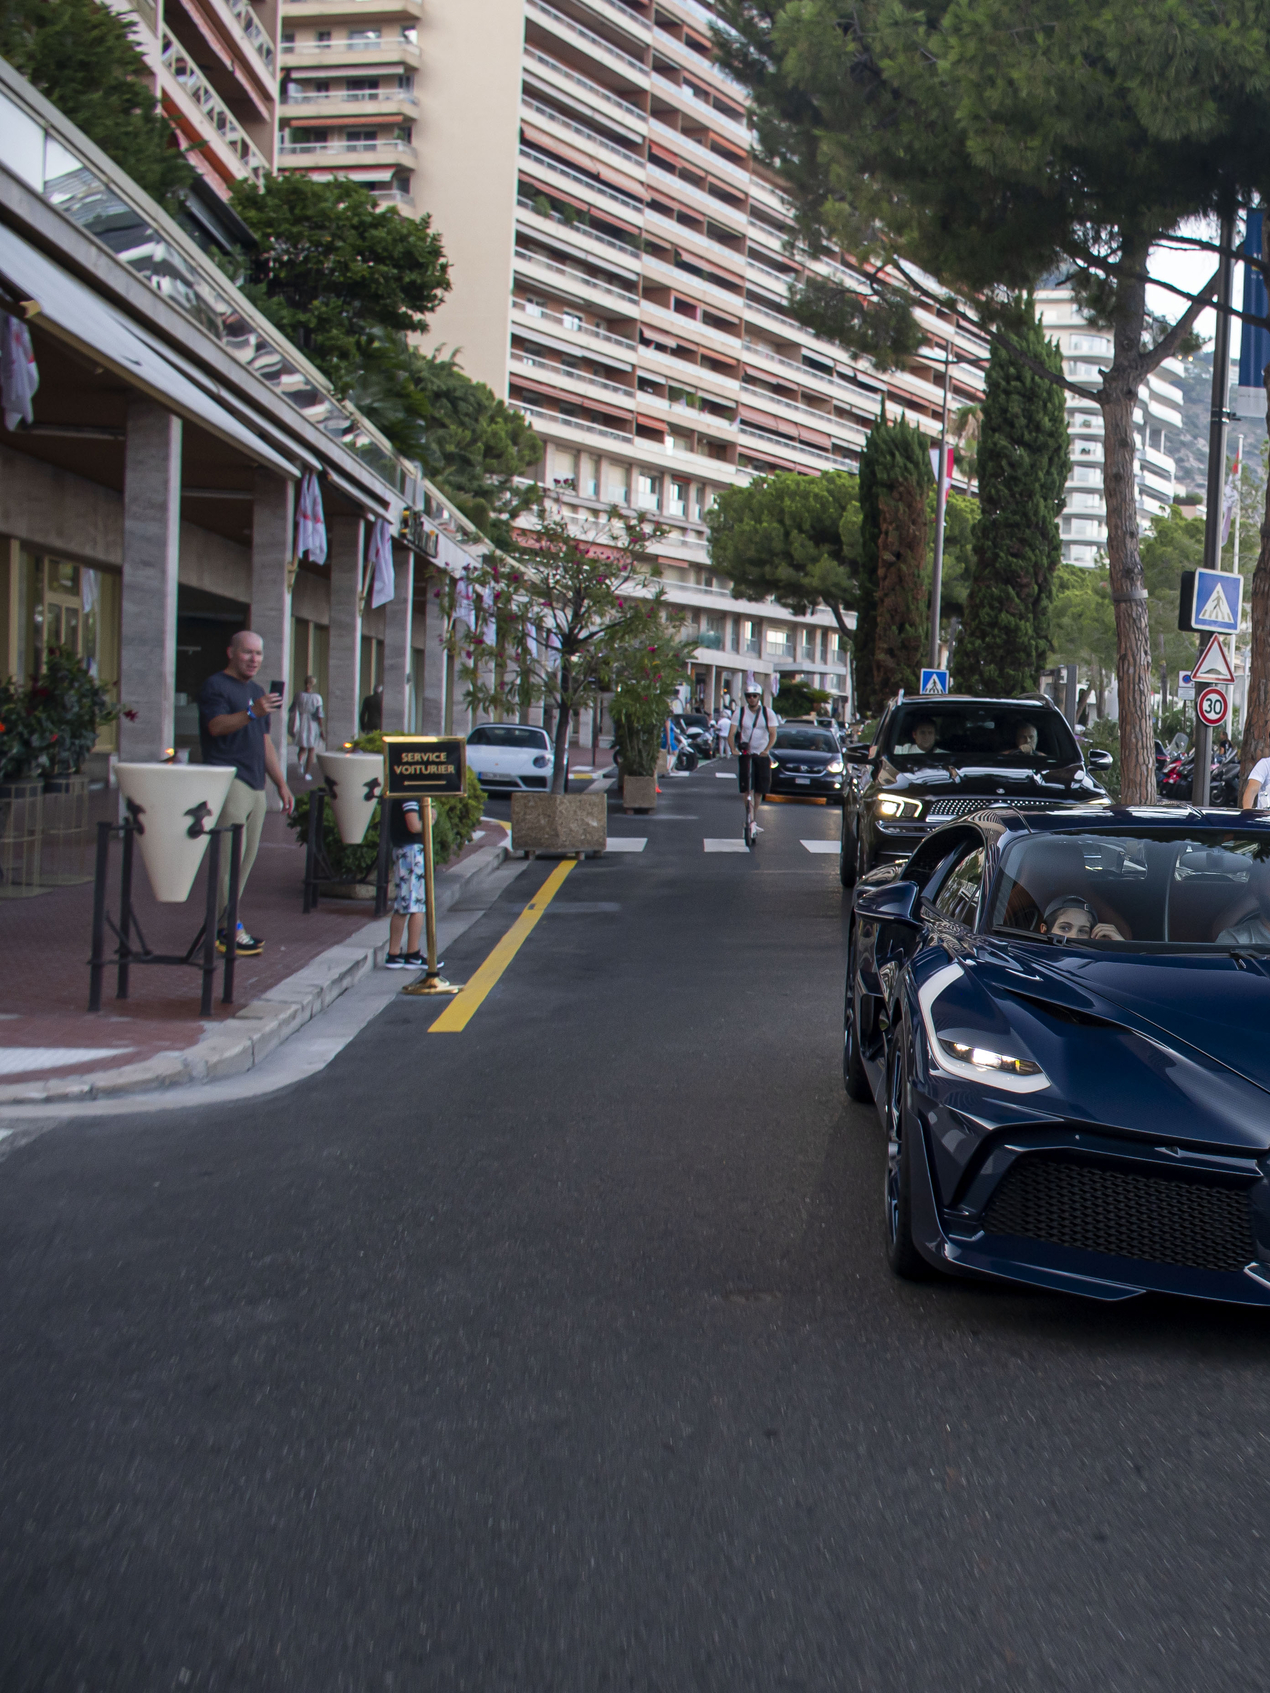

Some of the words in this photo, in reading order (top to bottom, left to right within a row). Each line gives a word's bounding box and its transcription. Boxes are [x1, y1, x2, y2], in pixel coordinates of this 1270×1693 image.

[1204, 697, 1223, 715] 30
[401, 752, 447, 762] SERVICE
[393, 764, 455, 775] VOITURIER
